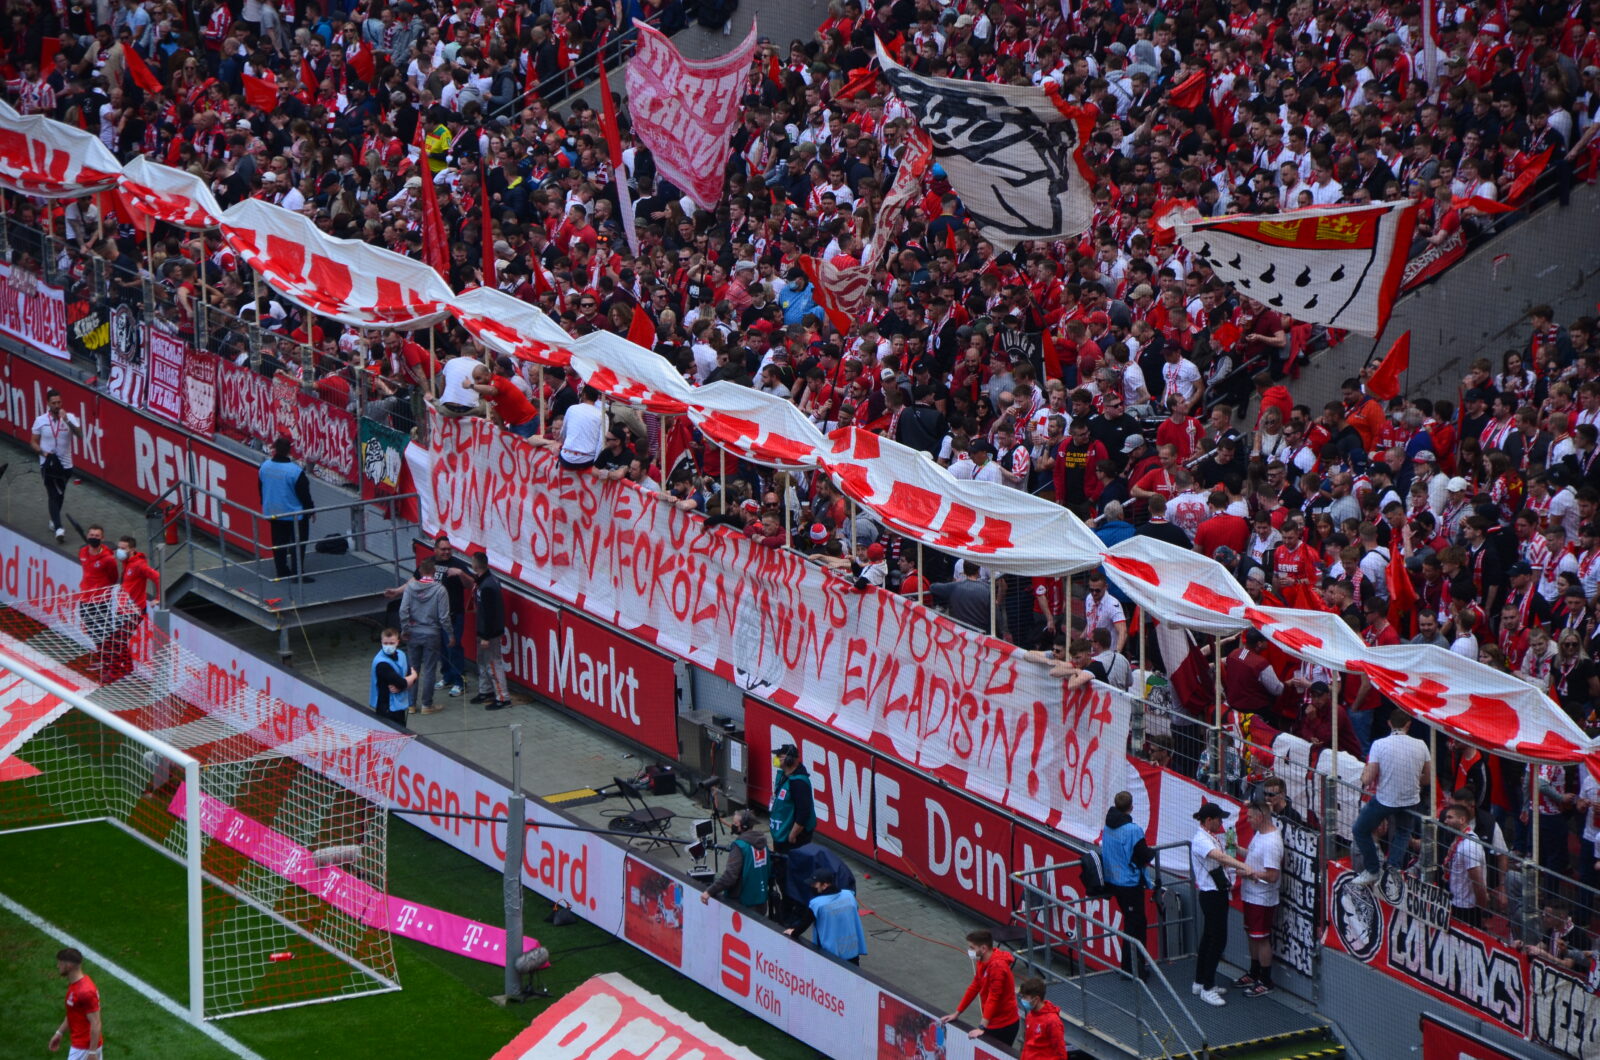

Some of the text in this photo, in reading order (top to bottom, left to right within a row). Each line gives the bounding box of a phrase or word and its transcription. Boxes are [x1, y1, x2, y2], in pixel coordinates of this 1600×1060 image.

[134, 425, 230, 529] REWE
[429, 407, 494, 459] SALIH
[1062, 678, 1113, 738] WH
[501, 612, 641, 726] ein Markt
[531, 492, 601, 581] SEN
[1060, 728, 1099, 809] 96
[925, 798, 1007, 909] Dein
[1019, 843, 1124, 964] Mark
[755, 984, 782, 1017] Köln
[756, 950, 846, 1017] Kreissparkasse
